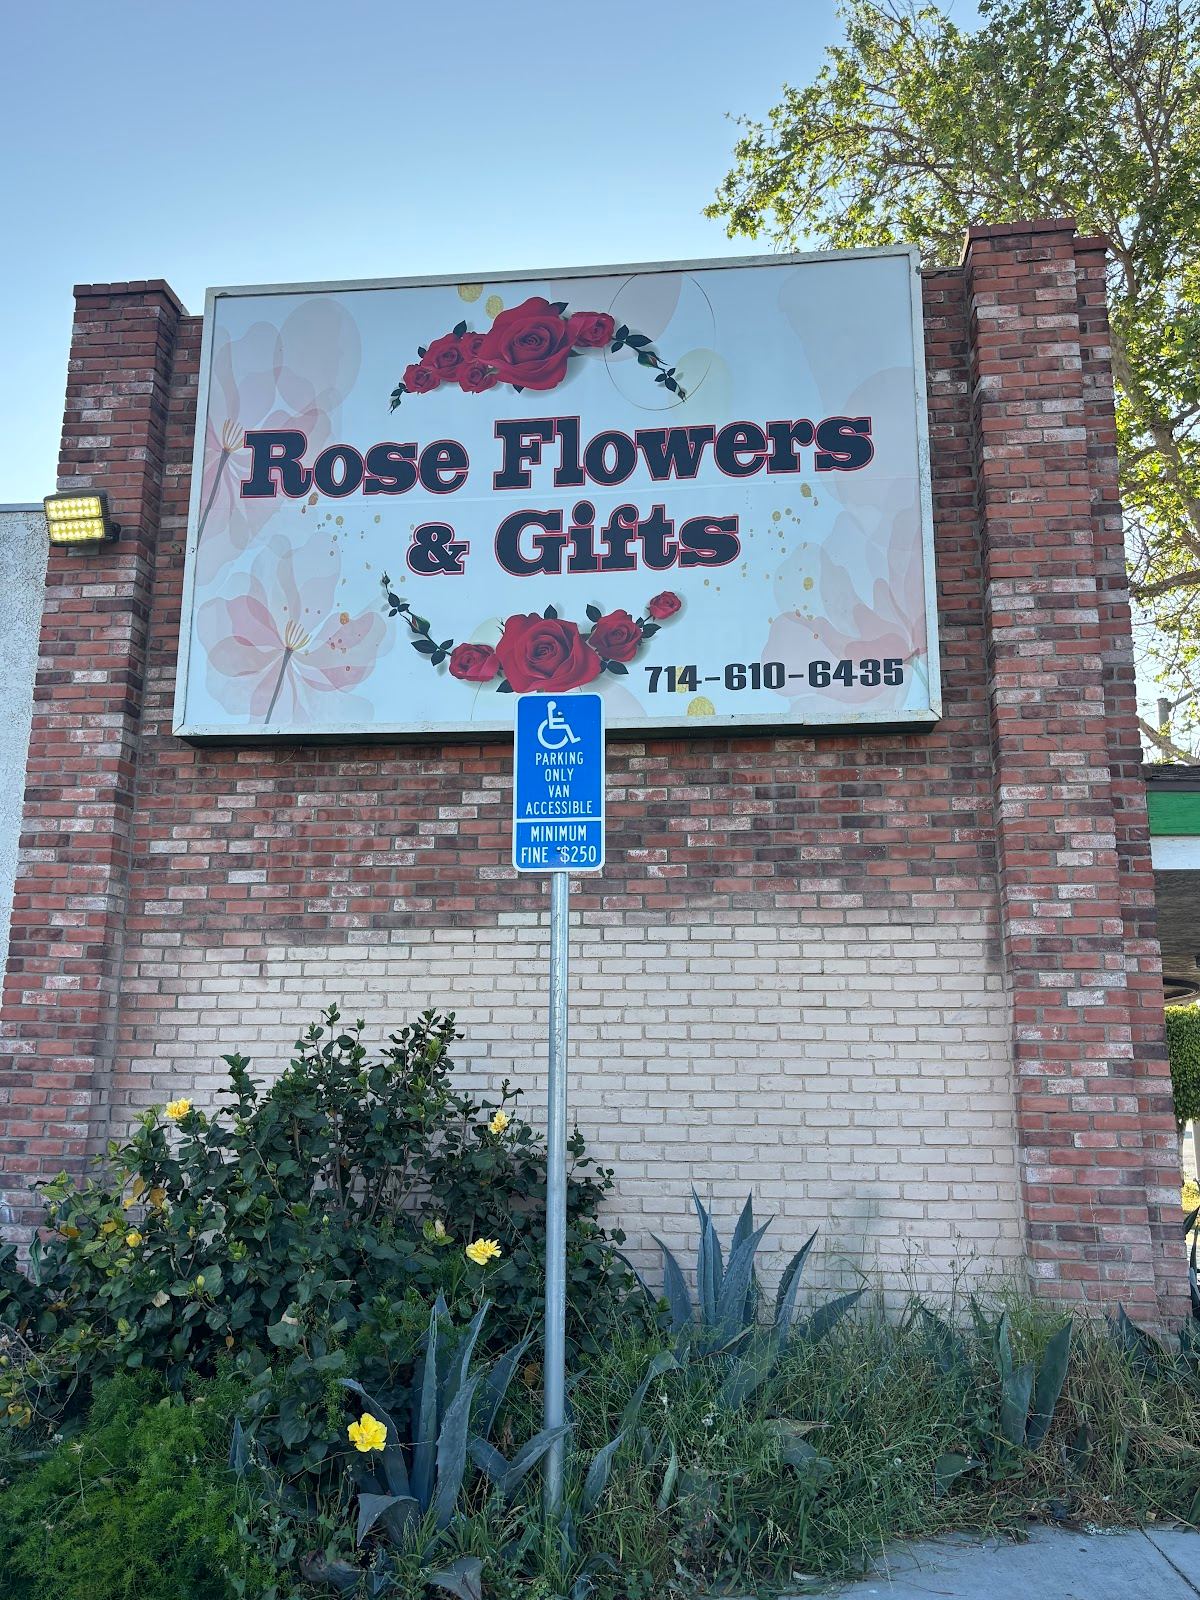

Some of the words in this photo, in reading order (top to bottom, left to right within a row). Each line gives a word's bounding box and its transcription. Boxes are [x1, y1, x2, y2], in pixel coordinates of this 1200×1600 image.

[240, 428, 469, 499] Rose
[492, 414, 875, 491] Flowers
[406, 521, 470, 576] &
[495, 499, 740, 577] Gifts
[644, 658, 905, 694] 714-610-6435
[535, 752, 584, 765] PARKING
[545, 769, 574, 782] ONLY
[549, 785, 570, 798] VAN
[526, 801, 593, 815] ACCESSIBLE
[531, 825, 587, 842] MINIMUM
[522, 847, 549, 863] FINE
[561, 846, 597, 864] $250
